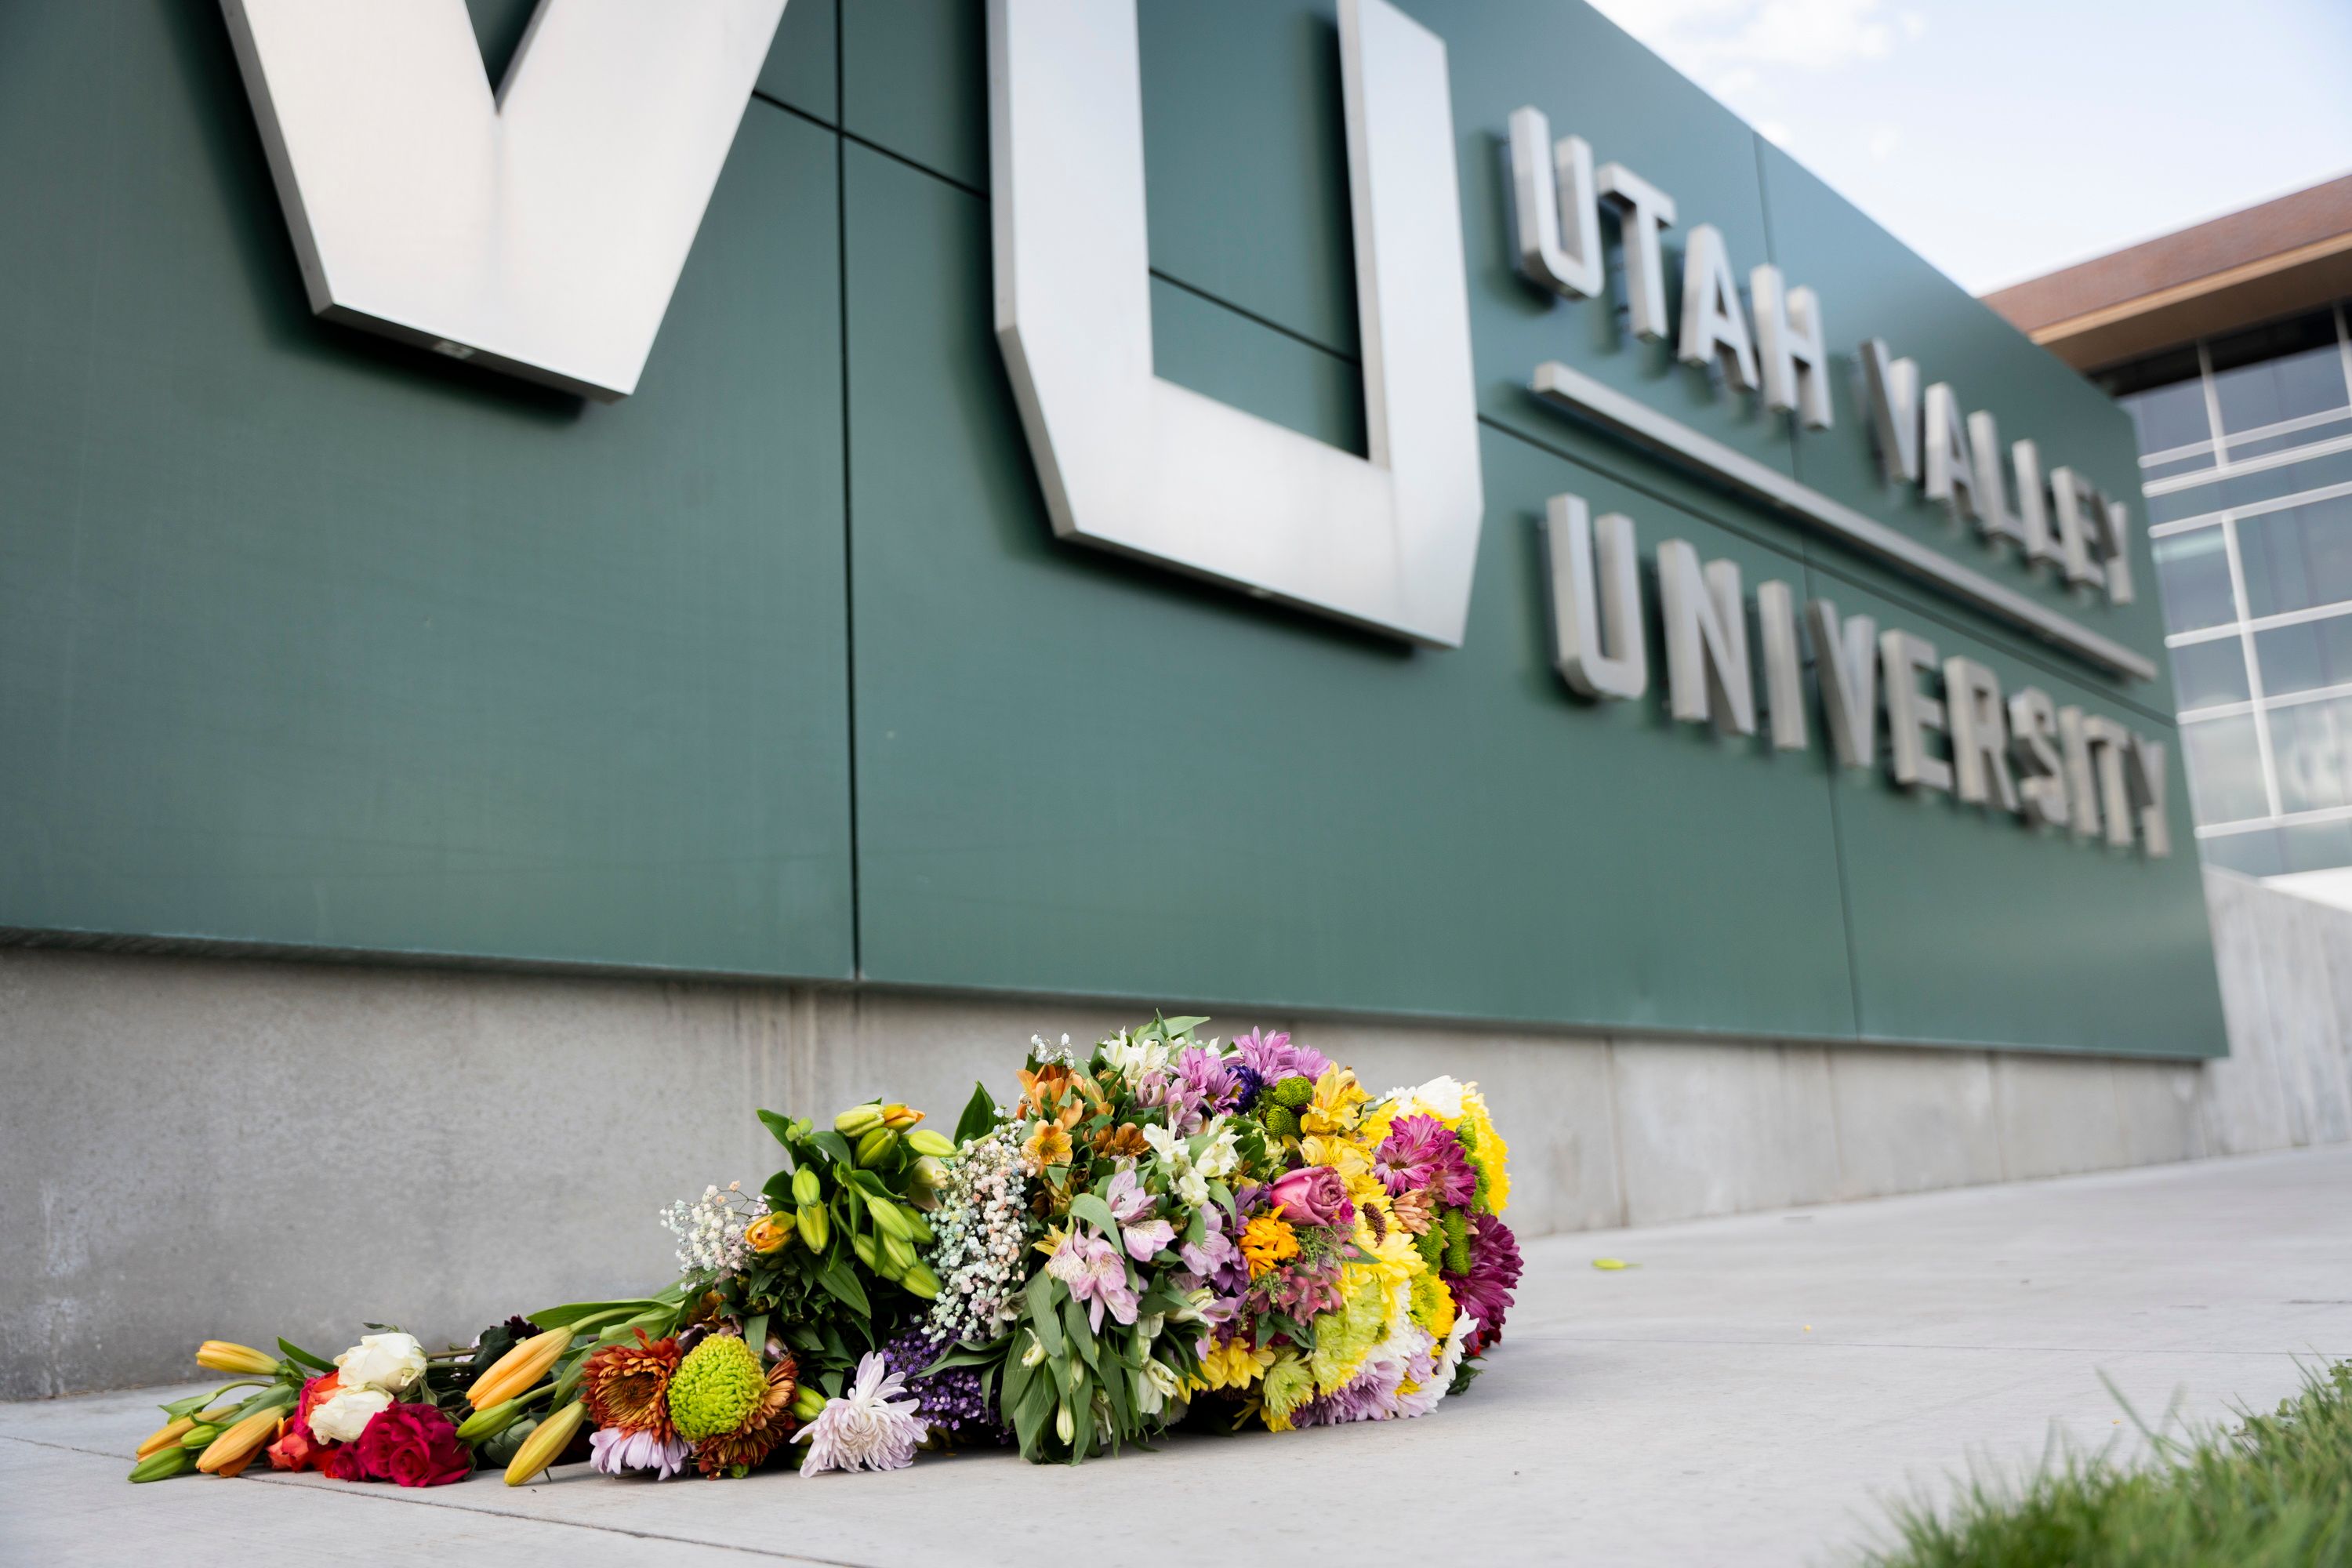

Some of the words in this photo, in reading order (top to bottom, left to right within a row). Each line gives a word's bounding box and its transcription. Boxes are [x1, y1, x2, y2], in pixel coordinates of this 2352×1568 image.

[1507, 105, 1833, 431] UTAH
[1860, 337, 2134, 605] VALLEY
[1546, 492, 2172, 859] UNIVERSITY
